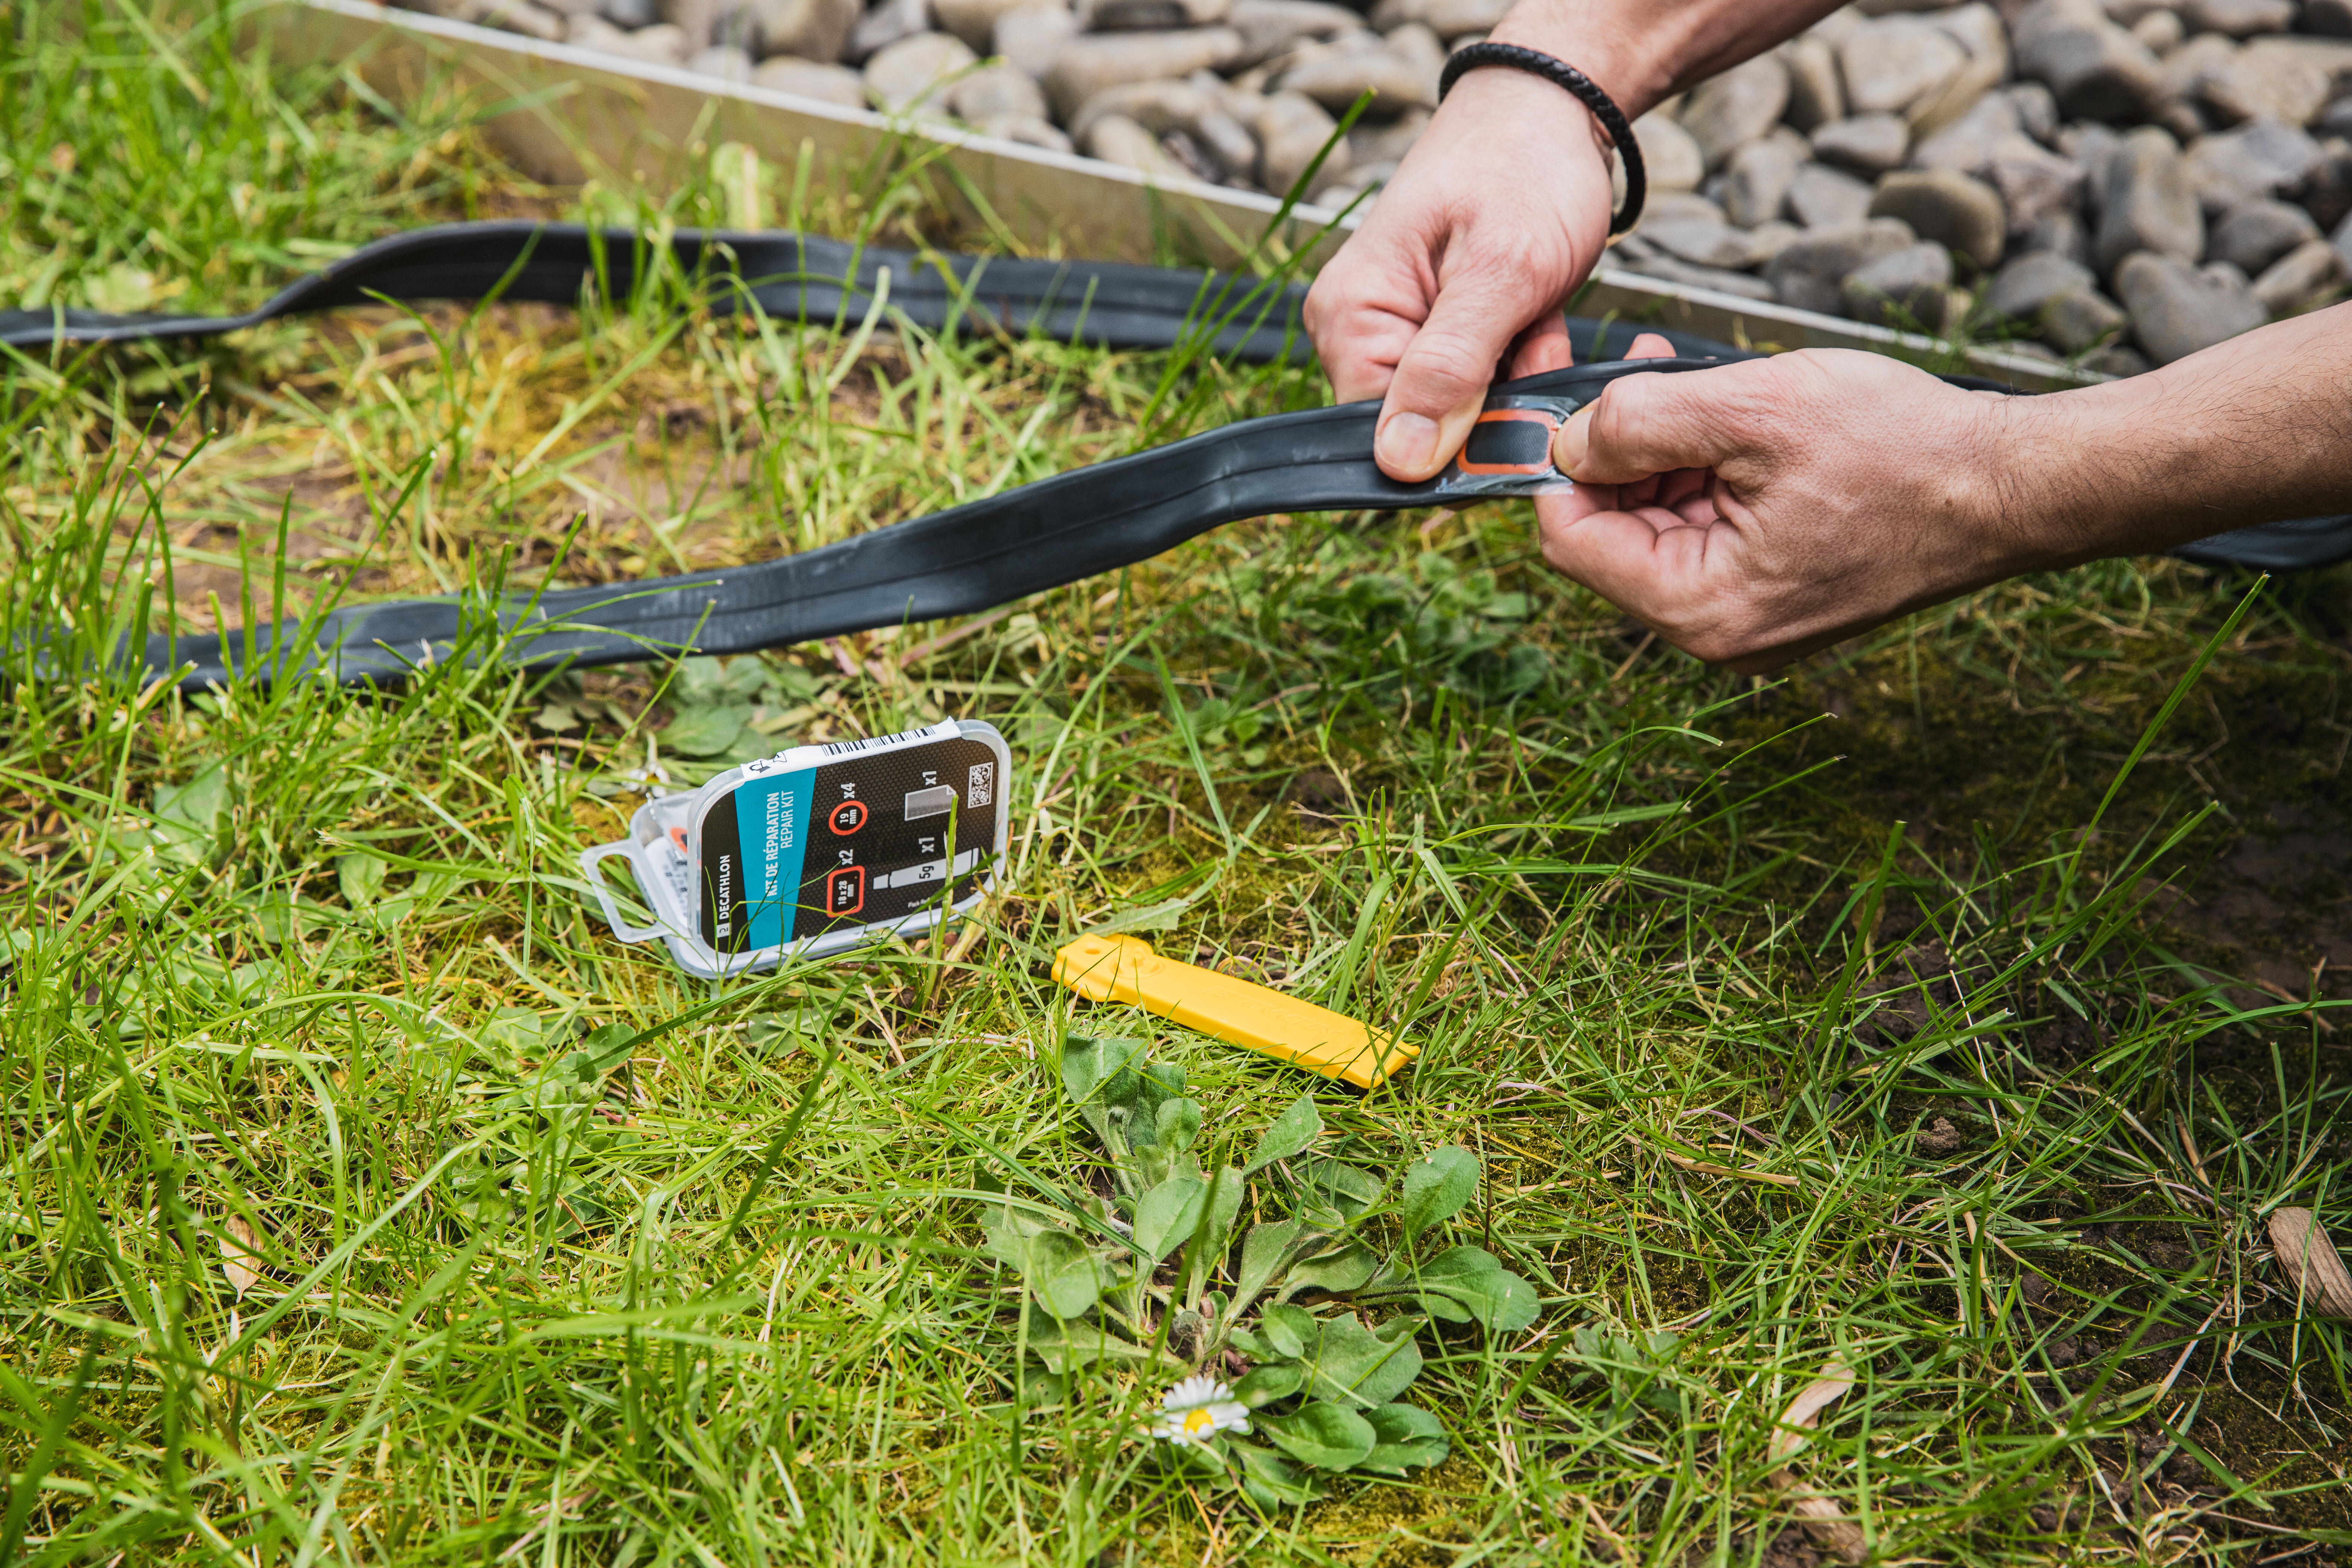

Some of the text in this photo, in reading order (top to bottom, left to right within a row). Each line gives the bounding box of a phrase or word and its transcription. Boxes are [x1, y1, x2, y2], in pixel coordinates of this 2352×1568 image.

[922, 770, 937, 786] x1
[841, 782, 855, 799] x4
[780, 791, 794, 848] REPAIR KIT
[840, 813, 849, 824] 19
[849, 809, 857, 825] mm
[763, 792, 779, 897] KIT DE RÉPARATION
[918, 837, 935, 853] x1
[839, 849, 853, 865] x2
[919, 865, 934, 879] 5g
[719, 854, 730, 920] DECATHLON
